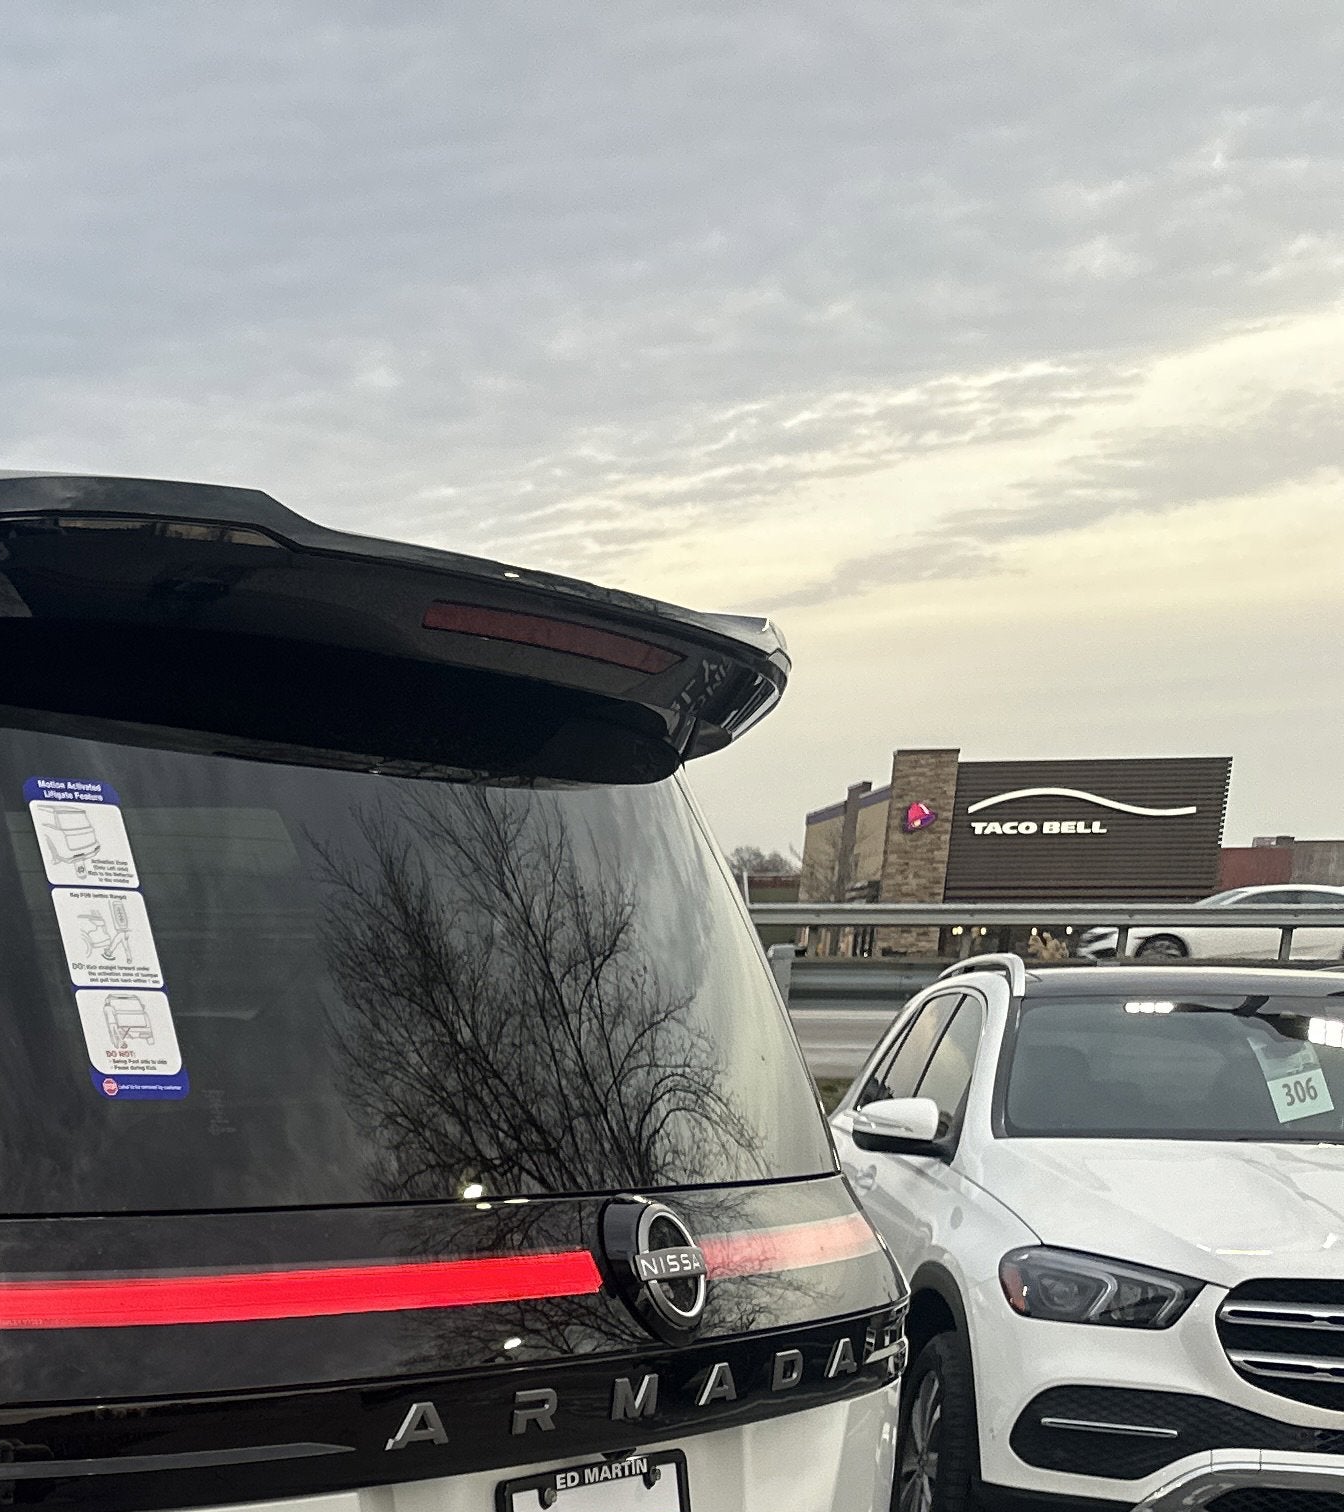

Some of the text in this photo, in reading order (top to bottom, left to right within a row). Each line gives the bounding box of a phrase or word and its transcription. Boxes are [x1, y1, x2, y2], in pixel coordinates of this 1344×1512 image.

[971, 820, 1108, 835] TACO BELL
[1282, 1077, 1318, 1107] 306
[384, 1337, 858, 1451] ARMADA
[556, 1457, 648, 1490] ED MARTIN
